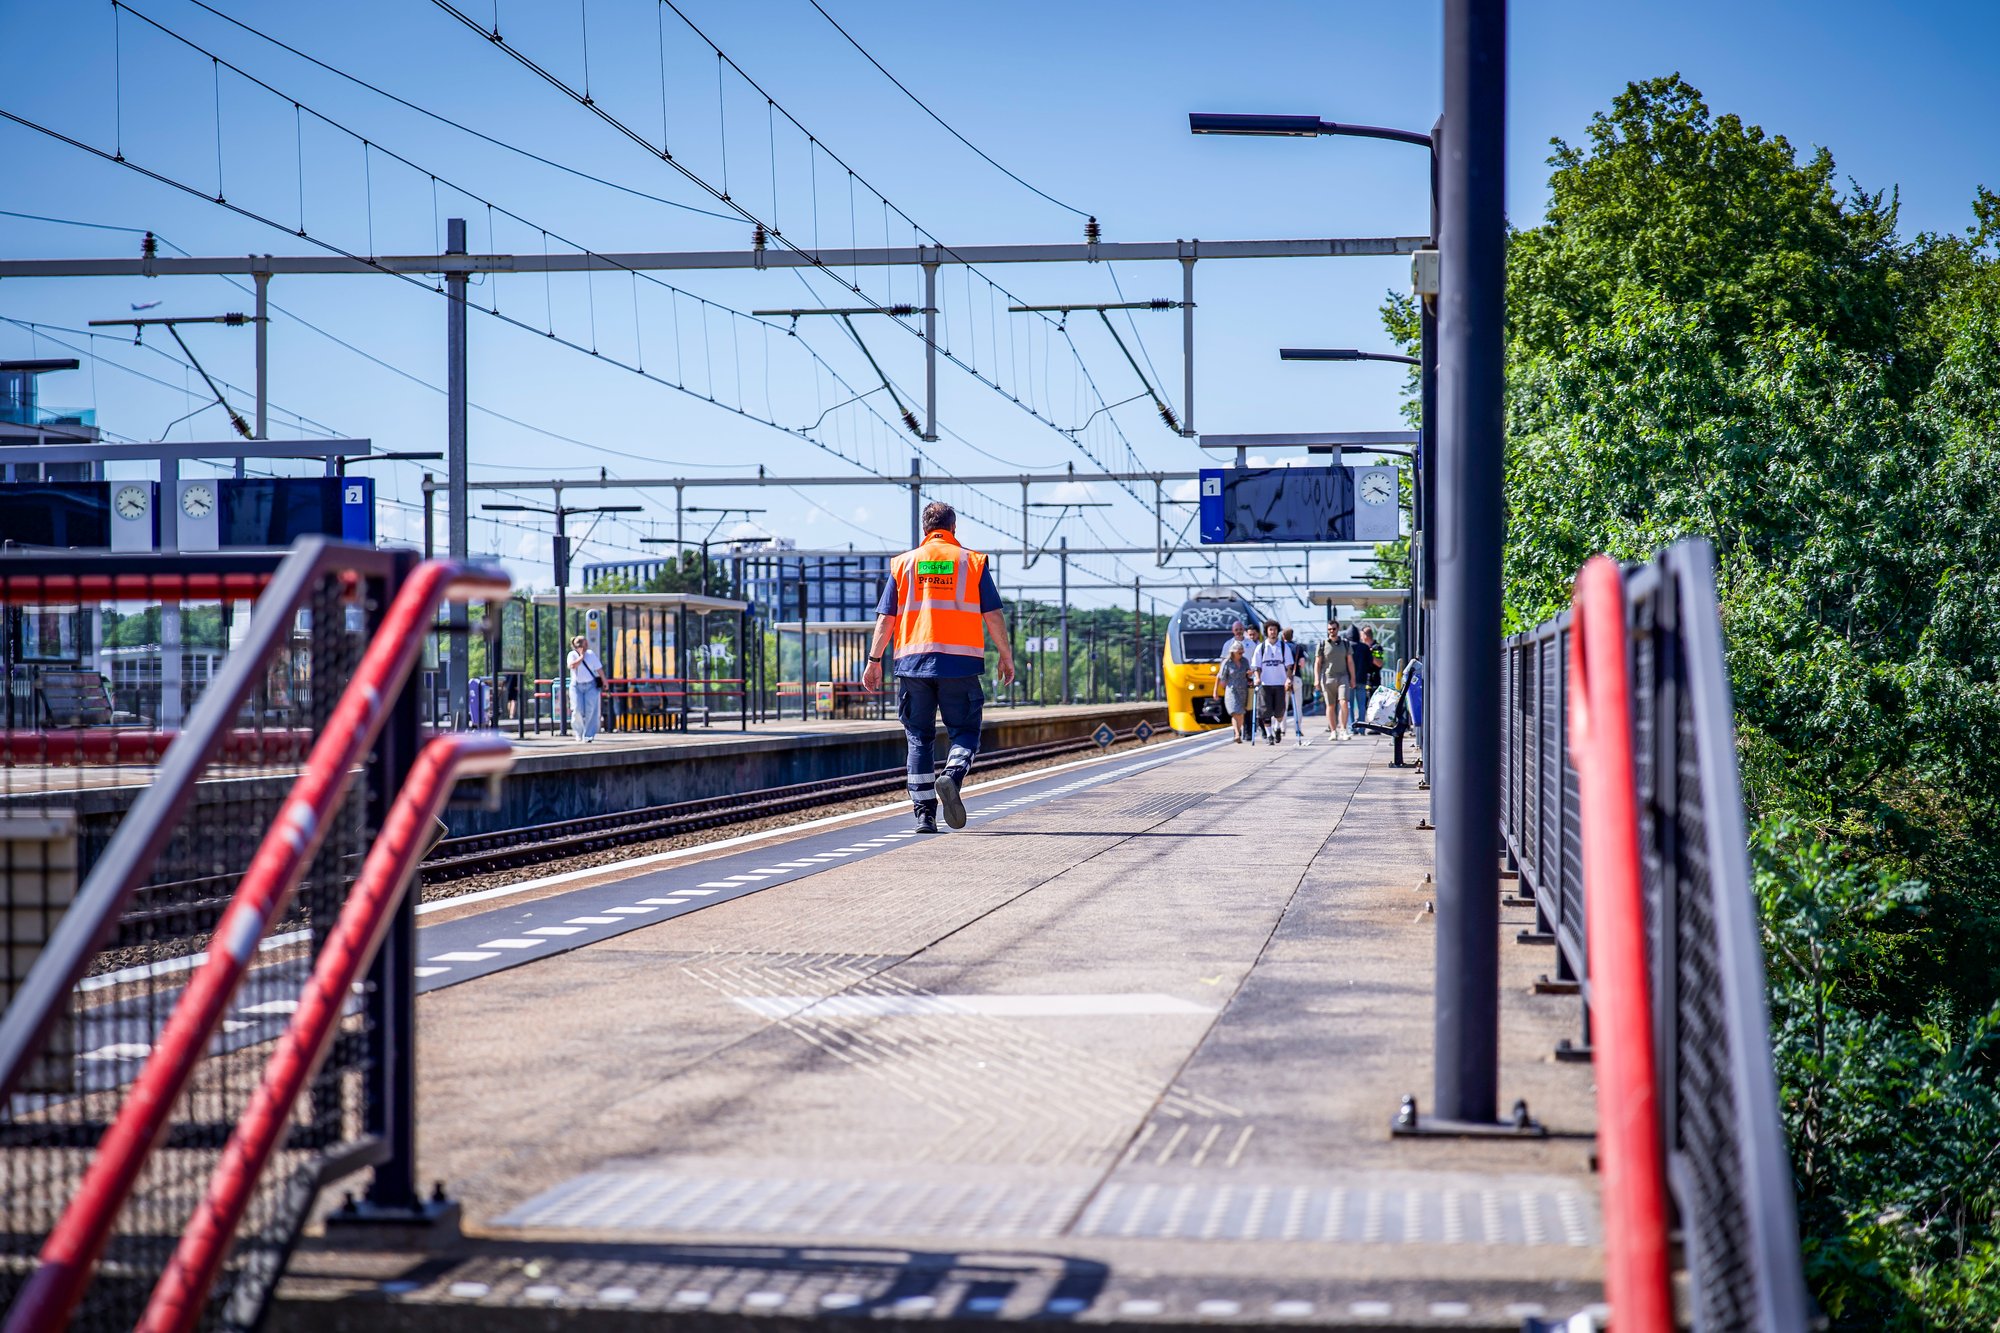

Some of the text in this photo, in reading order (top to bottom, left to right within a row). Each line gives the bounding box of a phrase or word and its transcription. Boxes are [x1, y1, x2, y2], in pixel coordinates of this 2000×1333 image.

[1209, 484, 1215, 494] 1
[350, 492, 358, 502] 2
[918, 576, 953, 585] ProRail
[1100, 731, 1109, 742] 2
[1140, 727, 1149, 737] 3
